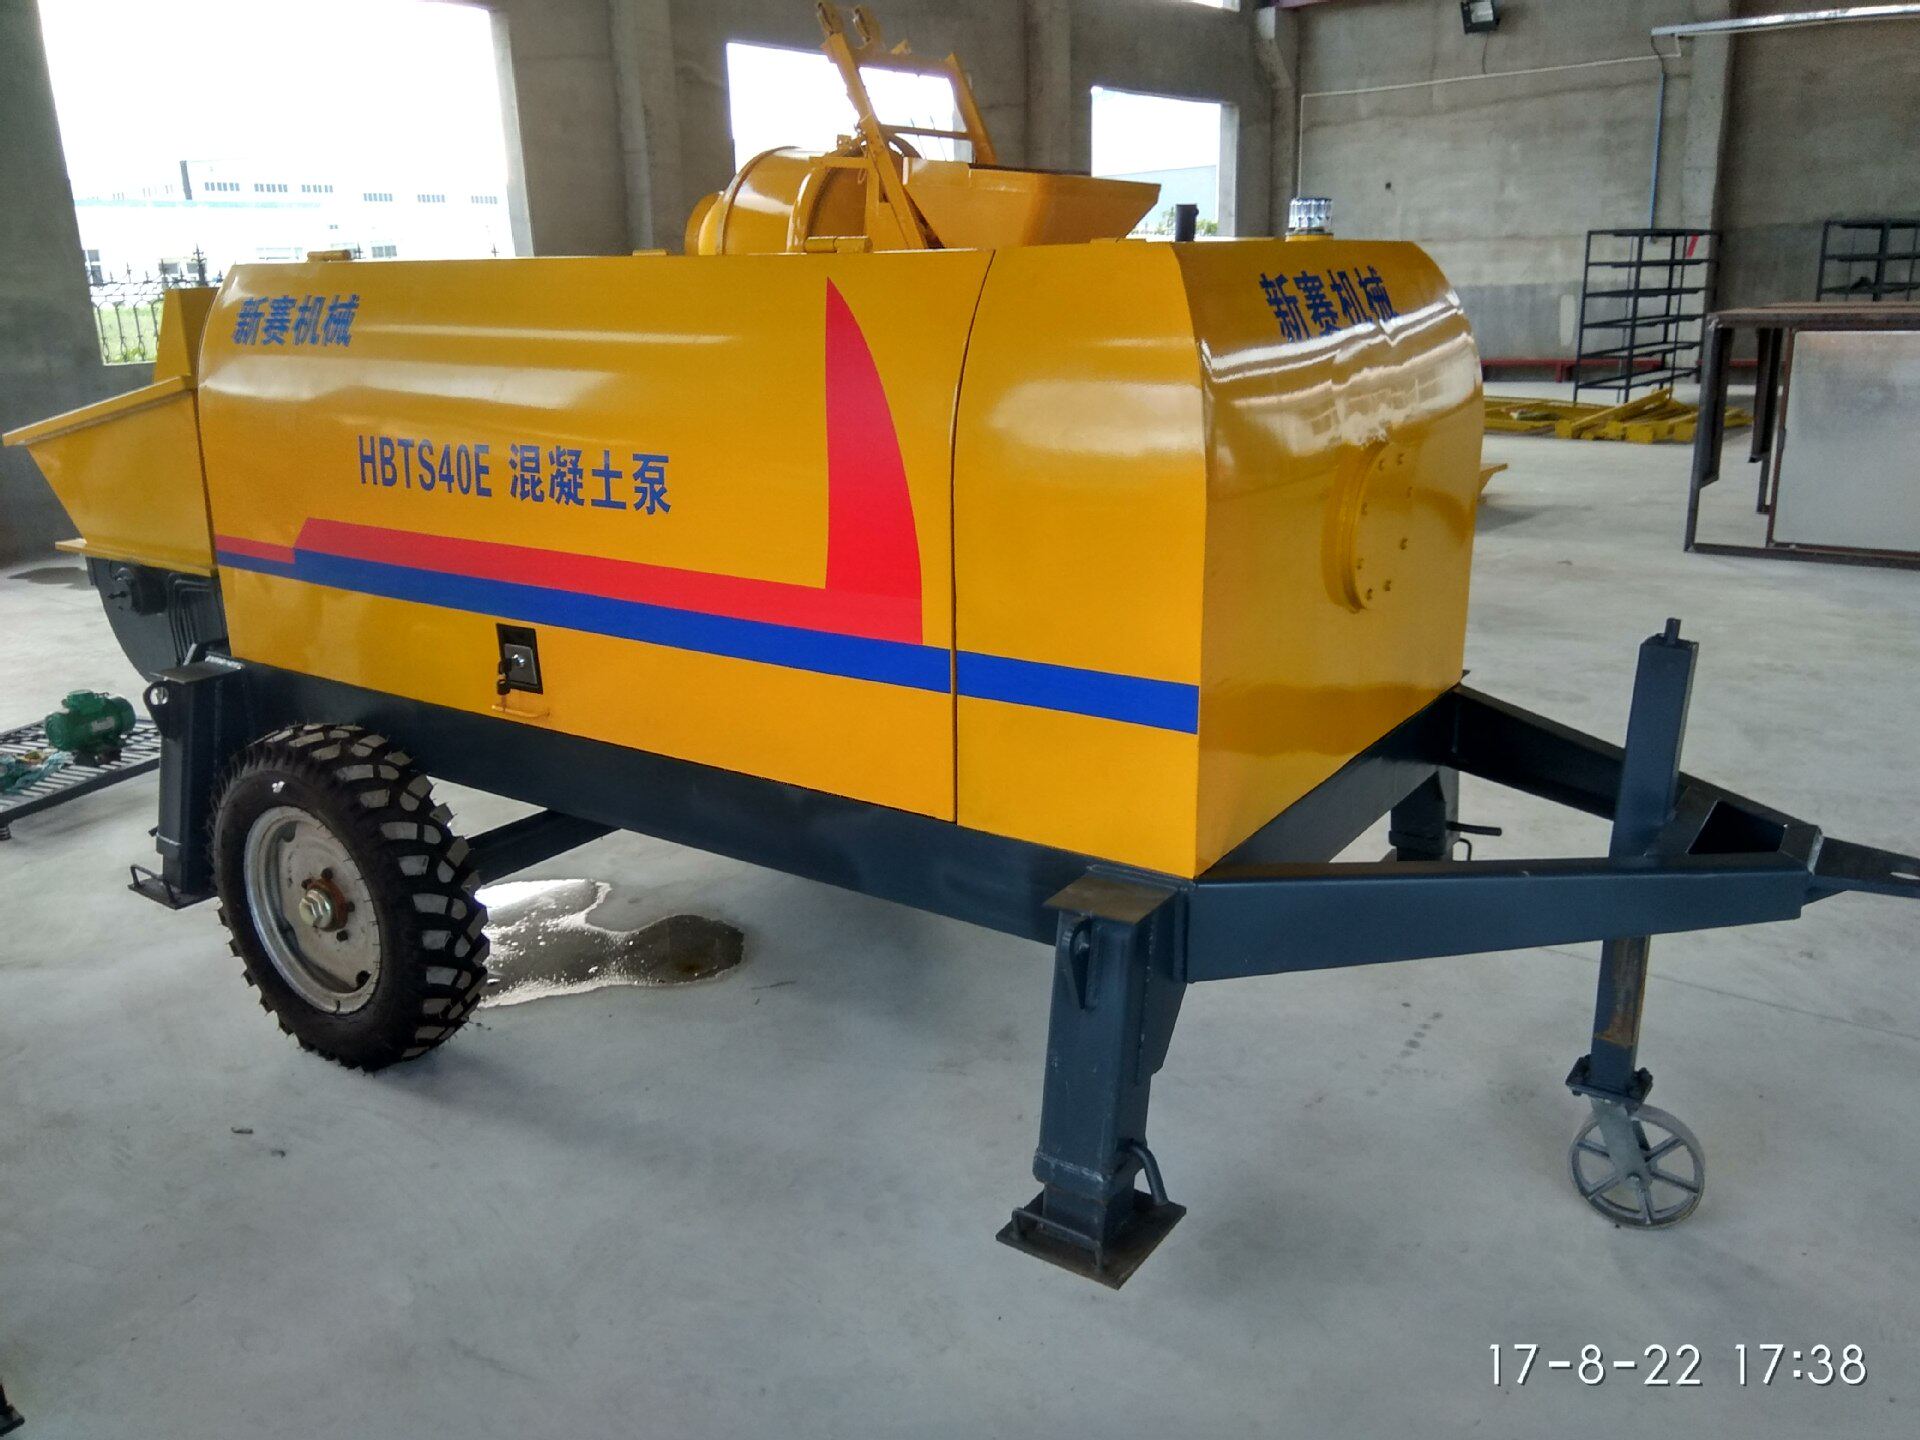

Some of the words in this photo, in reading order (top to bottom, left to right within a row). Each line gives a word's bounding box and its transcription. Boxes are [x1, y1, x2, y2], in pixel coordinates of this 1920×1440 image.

[233, 294, 359, 347] 新赛机械
[1259, 265, 1400, 343] 新赛机械
[358, 434, 492, 497] HBTS40E
[508, 443, 671, 515] 混凝土泵
